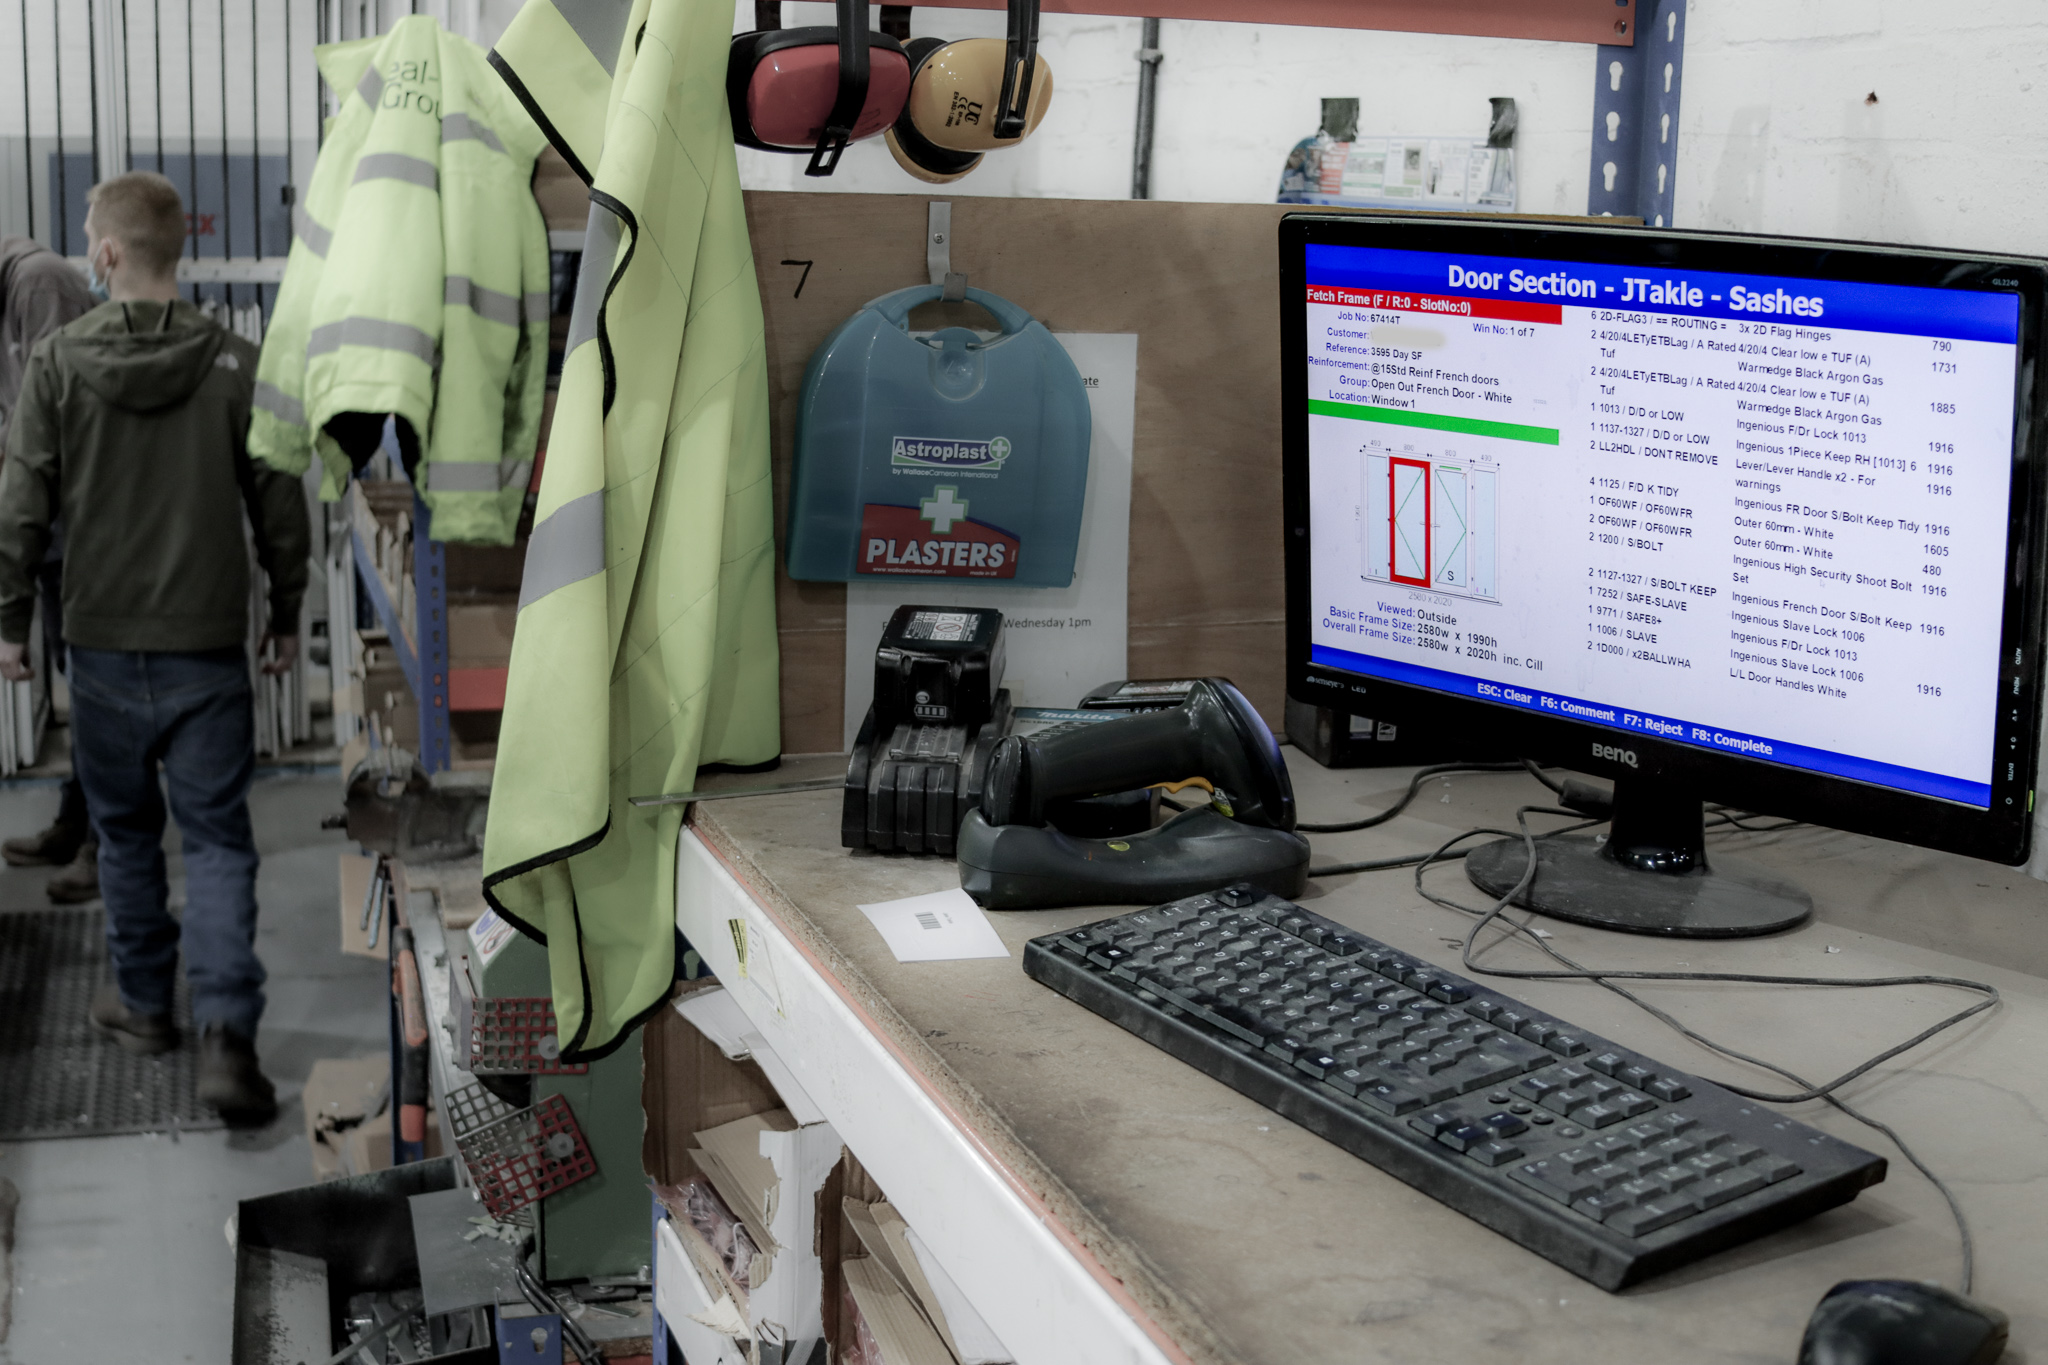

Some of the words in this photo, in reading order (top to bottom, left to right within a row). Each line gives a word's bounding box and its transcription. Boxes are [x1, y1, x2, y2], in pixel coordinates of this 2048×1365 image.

[781, 259, 813, 299] 7
[1992, 278, 2019, 288] GL2240
[1448, 264, 1503, 290] Door
[1509, 269, 1596, 298] Section
[1621, 277, 1703, 307] JTakle
[1729, 285, 1823, 317] Sashes
[1307, 288, 1334, 302] Fetch
[1337, 291, 1370, 304] Frame
[1420, 298, 1471, 316] SlotNo:0)
[1370, 313, 1400, 324] 67414T
[1600, 310, 1647, 324] 2D-FLAG3
[1671, 317, 1717, 330] ROUTING
[1326, 327, 1369, 339] Customer:
[1599, 330, 1688, 350] 4/20/4LETyETBLag
[1707, 340, 1736, 352] Rated
[1770, 325, 1792, 339] Flag
[1795, 328, 1831, 342] Hinges
[1325, 342, 1369, 355] Reference:
[1370, 346, 1390, 357] 3595
[1738, 343, 1767, 355] 4/20/4
[1771, 346, 1797, 358] Clear
[1932, 340, 1951, 352] 790
[1308, 355, 1369, 370] Reinforcement:
[1370, 362, 1406, 375] @15Std
[1408, 366, 1433, 378] Reinf
[1435, 369, 1468, 382] French
[1471, 373, 1499, 386] doors
[1737, 361, 1792, 378] Warmedge
[1795, 366, 1823, 379] Black
[1826, 370, 1859, 384] Argon
[1932, 362, 1956, 373] 1731
[1329, 389, 1370, 403] Location:
[1371, 394, 1408, 407] Window
[1339, 374, 1370, 389] Group:
[1371, 378, 1395, 390] Open
[1416, 383, 1449, 396] French
[1452, 387, 1475, 399] Door
[1483, 390, 1512, 403] White
[1599, 403, 1620, 414] 1013
[1930, 402, 1955, 414] 1885
[1599, 423, 1644, 436] 1137-1327
[1736, 418, 1784, 433] Ingenious
[1788, 424, 1810, 436] F/Dr
[1813, 427, 1838, 440] Lock
[1842, 431, 1866, 443] 1013
[894, 440, 987, 462] Astroplast
[1599, 441, 1635, 454] LL2HDL
[1644, 446, 1673, 459] DONT
[1675, 450, 1718, 465] REMOVE
[1736, 439, 1784, 454] Ingenious
[1788, 446, 1821, 459] 1Piece
[1824, 450, 1851, 464] Keep
[1873, 456, 1905, 472] [1013]
[892, 468, 902, 476] by
[903, 468, 960, 478] WallaceCameron
[960, 470, 998, 479] International
[1735, 458, 1794, 475] Lever/Lever
[1797, 466, 1832, 480] Handle
[1599, 477, 1620, 489] 1125
[1657, 485, 1679, 497] TIDY
[1735, 479, 1781, 493] warnings
[1598, 496, 1637, 510] OF60WF
[1645, 503, 1692, 518] OF60WFR
[1735, 496, 1782, 512] Ingenious
[1803, 505, 1828, 518] Door
[1831, 510, 1863, 523] S/Bolt
[1866, 515, 1893, 529] Keep
[1897, 519, 1920, 534] Tidy
[1597, 514, 1637, 528] OF60WF
[1644, 522, 1692, 537] OF60WFR
[1734, 516, 1762, 528] Outer
[1765, 520, 1794, 533] 60mm
[1803, 526, 1834, 539] White
[866, 538, 1006, 568] PLASTERS
[1598, 533, 1618, 544] 1200
[1627, 537, 1663, 551] S/BOLT
[873, 566, 946, 575] www.wallacecameron.com
[1733, 554, 1780, 570] Ingenious
[1784, 562, 1806, 576] High
[1810, 566, 1851, 583] Security
[1855, 573, 1886, 587] Shoot
[1890, 578, 1912, 591] Bolt
[1597, 569, 1642, 584] 1127-1327
[1650, 577, 1687, 592] S/BOLT
[1689, 584, 1716, 596] KEEP
[1597, 586, 1617, 599] 7252
[1626, 592, 1687, 611] SAFE-SLAVE
[1376, 601, 1415, 617] Viewed:
[1417, 608, 1456, 625] Outside
[1596, 605, 1616, 617] 9771
[1626, 611, 1662, 625] SAFE8+
[1732, 591, 1779, 608] Ingenious
[1782, 599, 1817, 614] French
[1820, 606, 1846, 619] Door
[1849, 611, 1880, 625] S/Bolt
[1885, 617, 1912, 632] Keep
[1004, 618, 1065, 629] Wednesday
[1069, 618, 1092, 628] 1pm
[1329, 605, 1355, 620] Basic
[1358, 611, 1389, 626] Frame
[1391, 617, 1415, 631] Size:
[1417, 622, 1449, 638] 2580w
[1467, 632, 1497, 648] 1990h
[1596, 624, 1617, 636] 1006
[1626, 629, 1657, 644] SLAVE
[1731, 610, 1779, 627] Ingenious
[1782, 619, 1810, 633] Slave
[1813, 624, 1837, 637] Lock
[1841, 629, 1865, 642] 1006
[1322, 617, 1355, 633] Overall
[1359, 624, 1388, 640] Frame
[1392, 631, 1415, 645] Size:
[1417, 636, 1448, 651] 2580w
[1466, 646, 1496, 661] 2020h
[1503, 654, 1521, 666] inc.
[1525, 658, 1542, 671] Cill
[1596, 642, 1623, 655] 1D000
[1632, 649, 1691, 668] x2BALLWHA
[1748, 670, 1771, 683] Door
[1775, 676, 1814, 692] Handles
[1817, 684, 1846, 698] White
[1036, 712, 1114, 720] makita
[1477, 682, 1500, 697] ESC:
[1504, 688, 1532, 703] Clear
[1560, 700, 1615, 721] Comment
[1645, 717, 1683, 736] Reject
[1713, 732, 1772, 755] Complete
